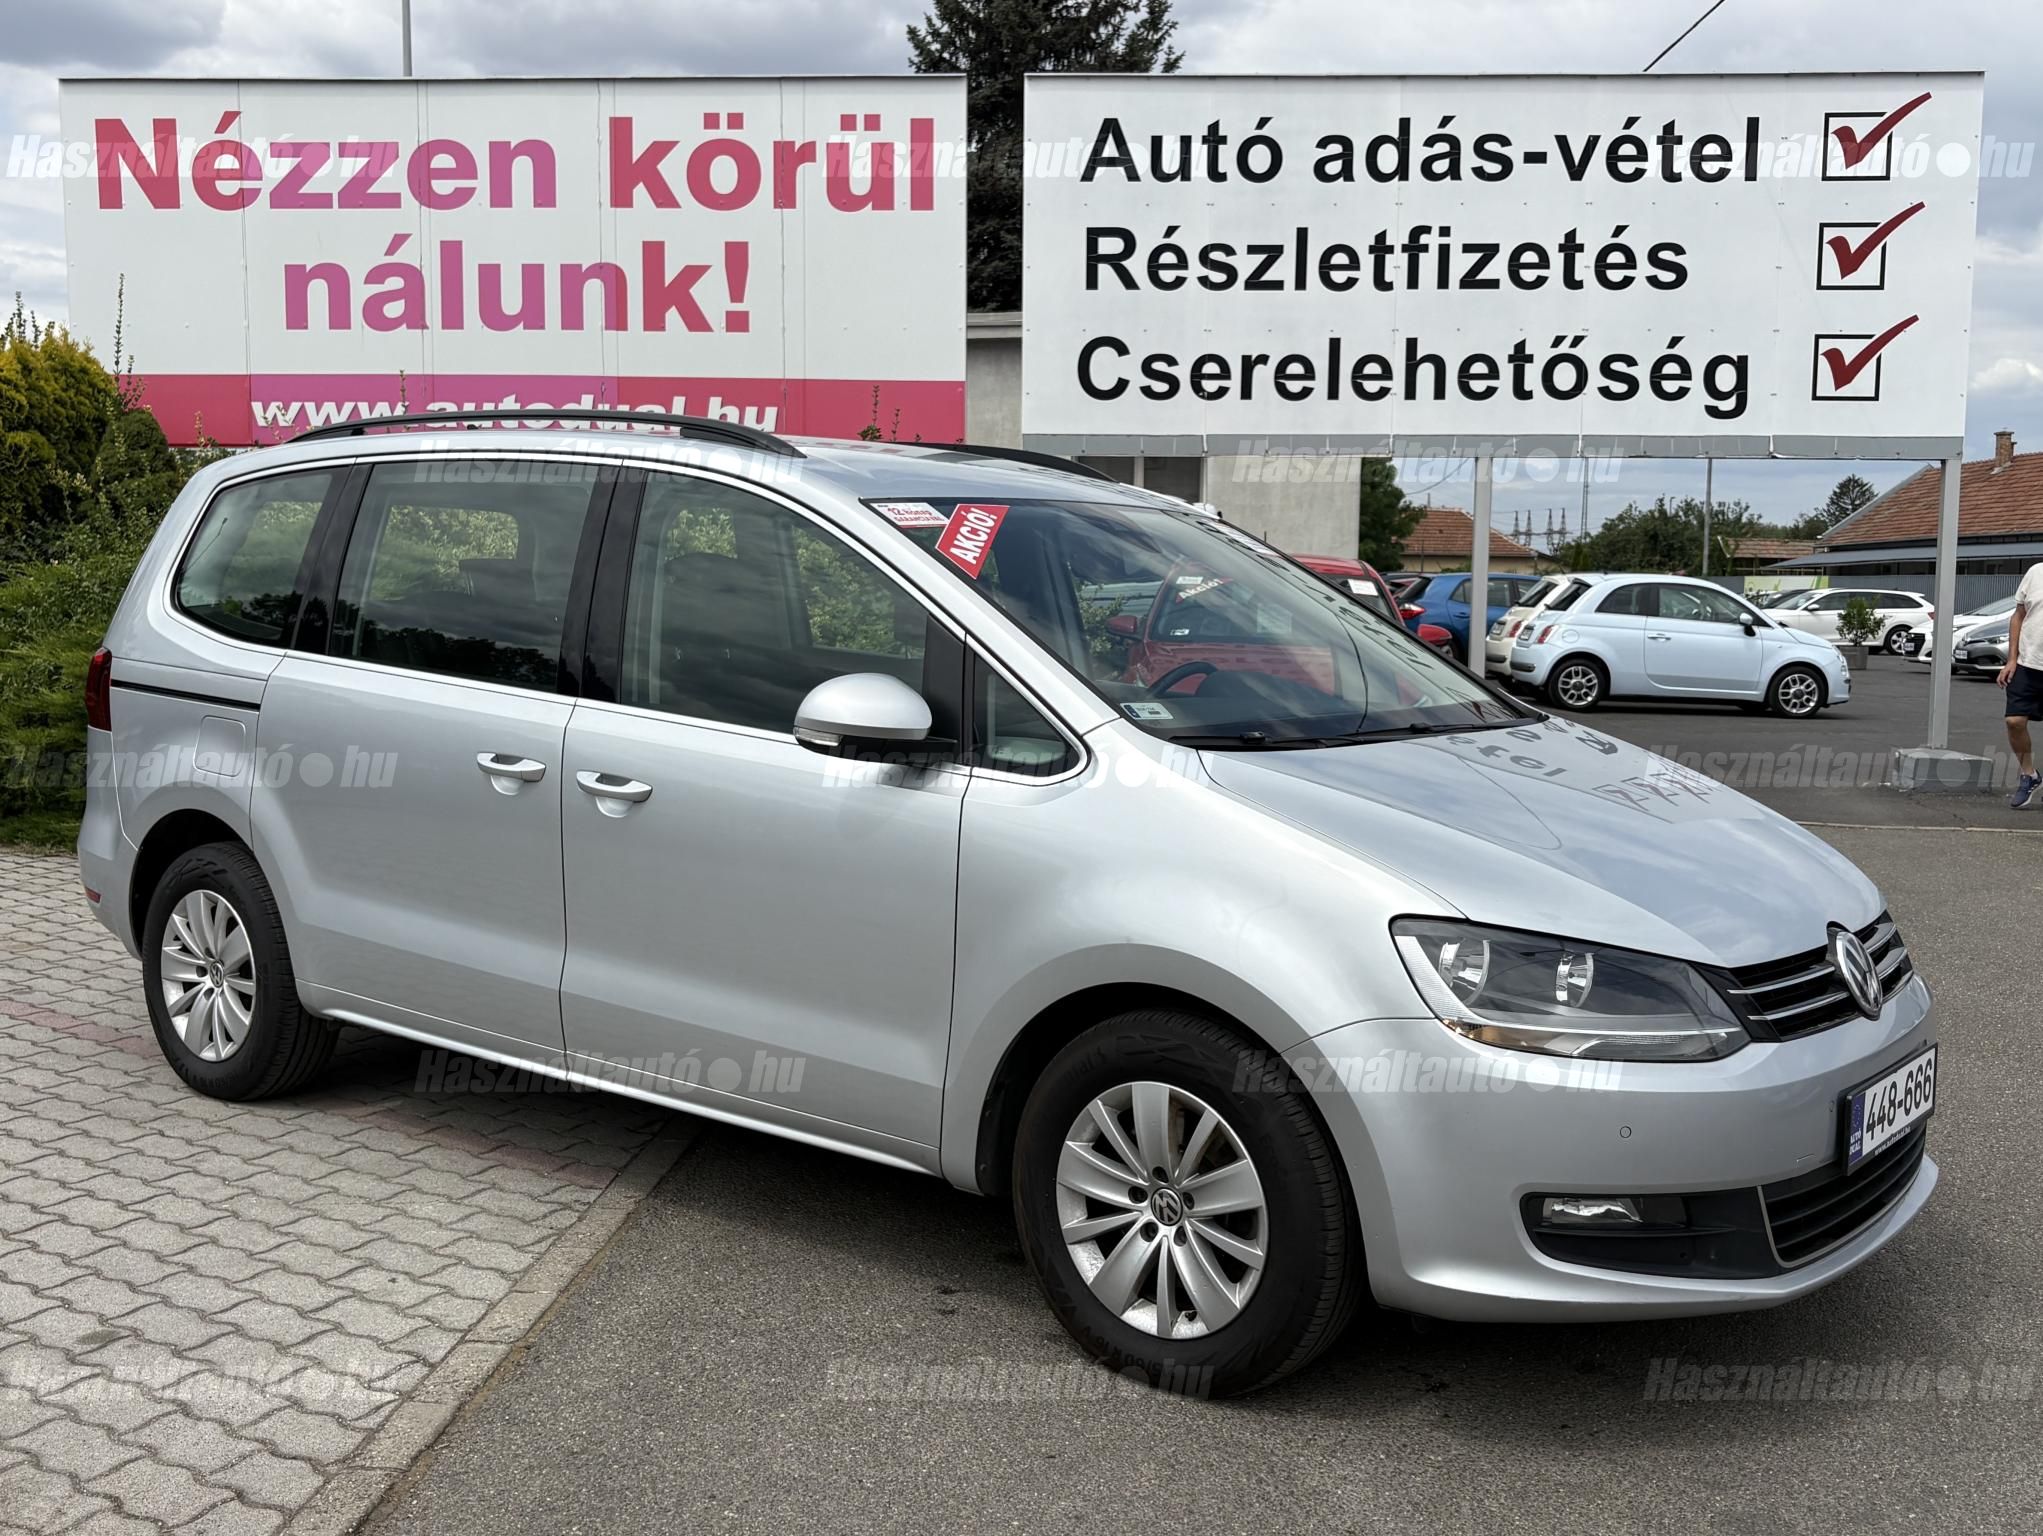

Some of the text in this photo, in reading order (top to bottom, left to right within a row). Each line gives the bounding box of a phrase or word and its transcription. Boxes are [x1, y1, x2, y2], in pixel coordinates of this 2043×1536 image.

[95, 111, 935, 213] Nézzen körül
[1080, 115, 1760, 183] Autó adás-vétel
[284, 233, 751, 334] nálunk!
[1087, 225, 1688, 291] Részletfizetés
[251, 394, 778, 433] wwwautodualhu
[1078, 335, 1749, 420] Cserelehetőség
[949, 507, 998, 565] AKCIÓ!
[1866, 1057, 1933, 1141] 448-666
